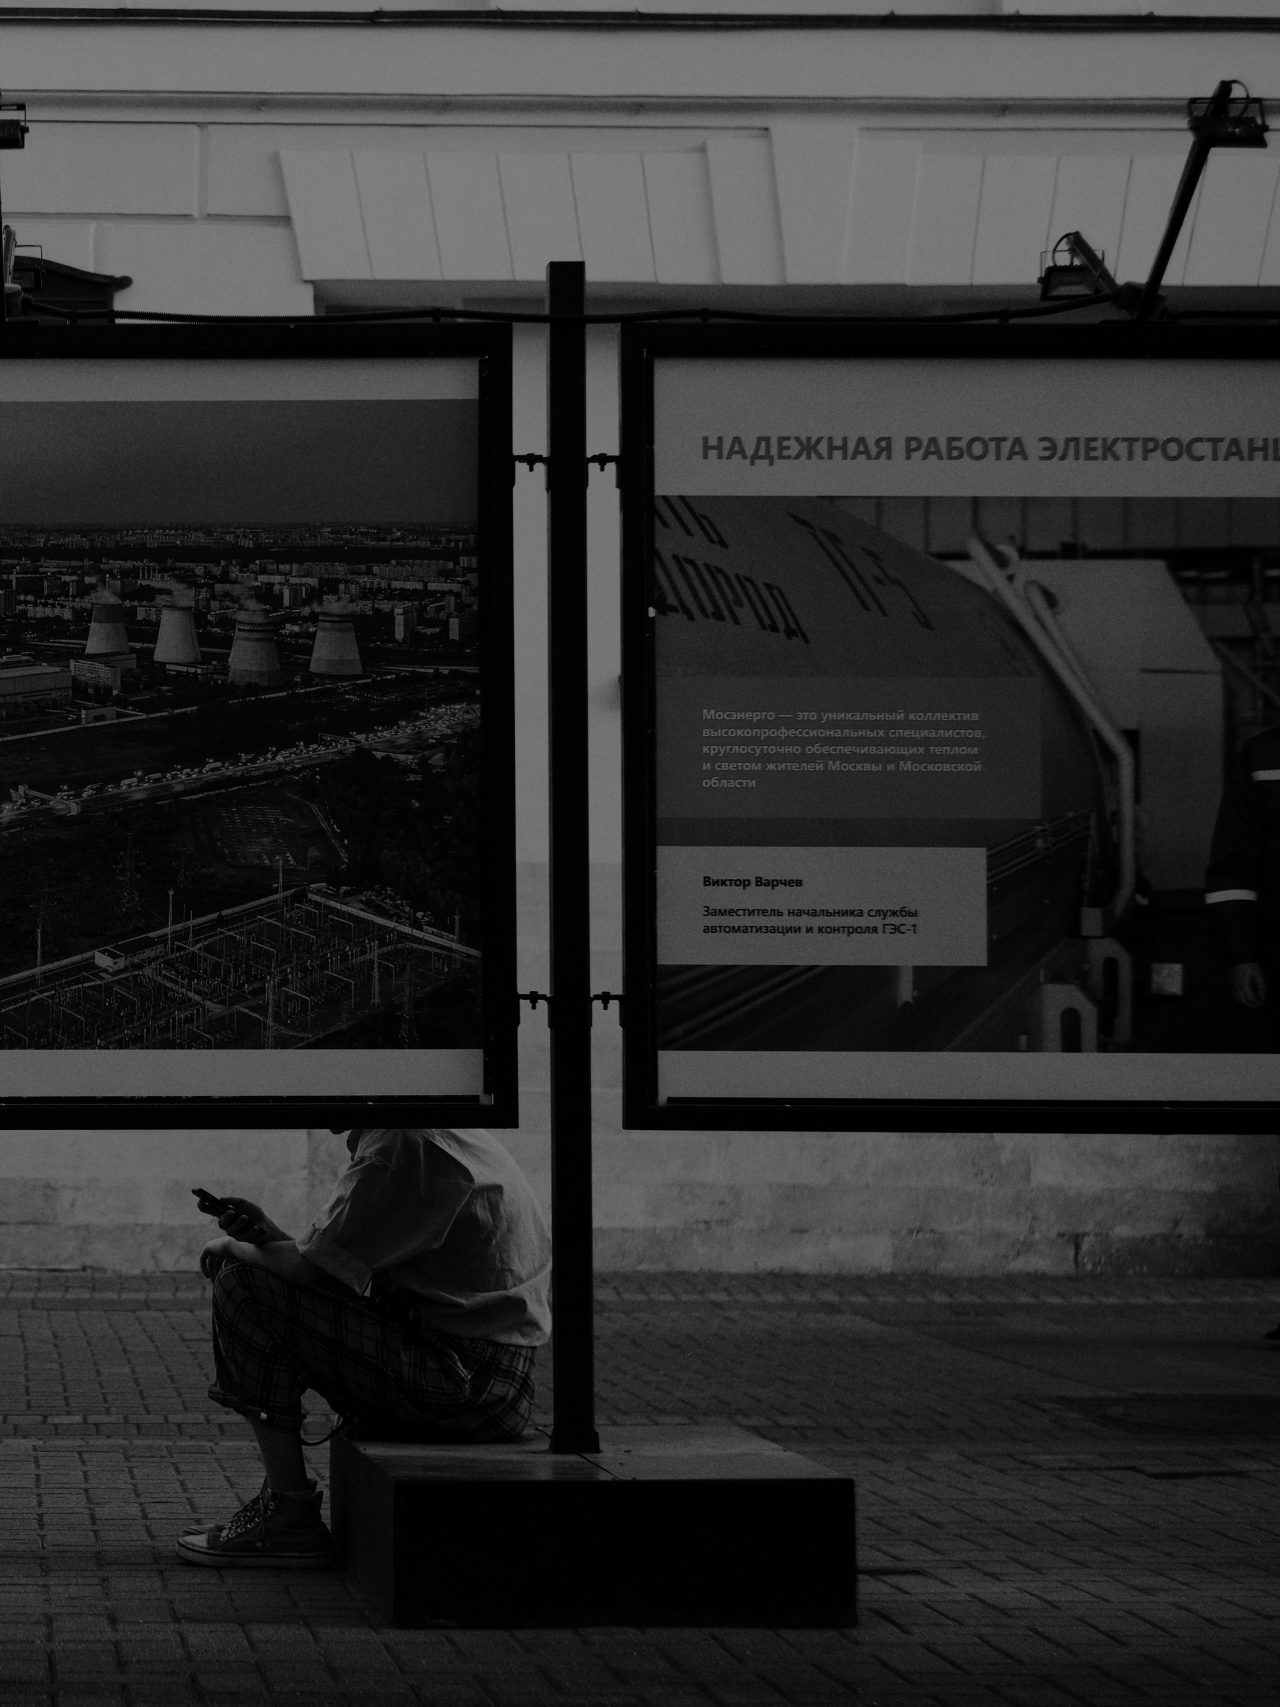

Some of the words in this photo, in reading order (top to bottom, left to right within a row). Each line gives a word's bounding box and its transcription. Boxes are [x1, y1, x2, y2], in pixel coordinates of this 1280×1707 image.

[702, 435, 892, 466] НАДЕЖНАЯ
[904, 436, 1029, 462] РАБОТА
[702, 708, 776, 723] Мосэнерго
[796, 711, 818, 721] это
[820, 709, 905, 724] уникальный
[908, 711, 979, 721] коллектив
[702, 726, 885, 740] высокопрофессиональных
[888, 728, 985, 740] специалистов,
[702, 744, 802, 757] круглосуточно
[805, 742, 925, 757] обеспечивающих
[928, 746, 978, 756] теплом
[702, 762, 711, 771] и
[714, 762, 762, 771] светом
[765, 759, 824, 771] жителей
[827, 760, 882, 772] Москвы
[886, 763, 895, 771] и
[899, 760, 982, 773] Московской
[702, 776, 757, 788] области
[702, 875, 752, 890] Виктор
[754, 876, 803, 891] Варчев
[702, 905, 785, 917] Заместитель
[787, 908, 864, 918] начальника
[867, 906, 918, 921] службы
[702, 925, 802, 937] автоматизации
[805, 925, 814, 934] и
[817, 925, 878, 938] контроля
[882, 923, 917, 935] ГЭС-1
